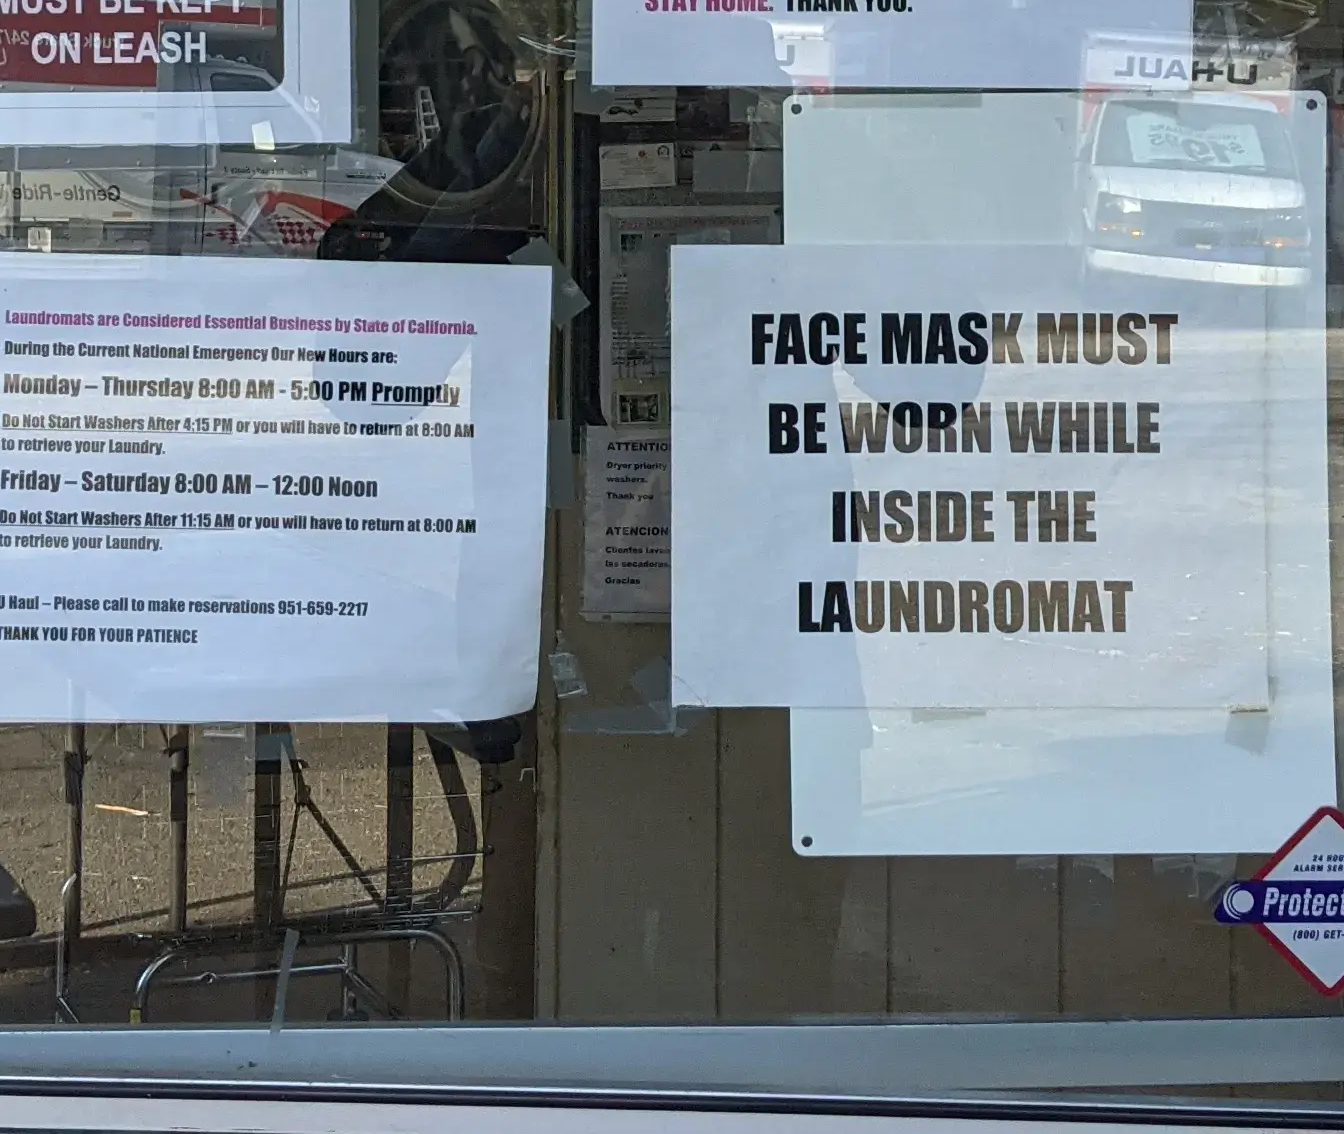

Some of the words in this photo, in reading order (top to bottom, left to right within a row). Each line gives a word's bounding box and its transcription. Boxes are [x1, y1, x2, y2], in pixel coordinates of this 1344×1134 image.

[31, 31, 83, 64] ON
[93, 31, 207, 64] LEASH
[3, 309, 95, 328] Laundromats
[95, 314, 121, 329] are
[121, 312, 202, 331] Considered
[203, 313, 268, 332] Essential
[267, 315, 333, 333] Business
[333, 316, 353, 338] by
[352, 316, 390, 335] State
[390, 317, 407, 335] of
[406, 318, 478, 337] California.
[750, 311, 868, 365] FACE
[879, 310, 1025, 365] MASK
[1035, 312, 1179, 365] MUST
[2, 339, 51, 362] During
[51, 340, 76, 358] the
[76, 341, 131, 359] Current
[131, 342, 190, 360] National
[191, 343, 269, 366] Emergency
[269, 345, 295, 363] Our
[295, 345, 327, 363] New
[327, 346, 369, 364] Hours
[369, 350, 398, 365] are:
[1, 373, 82, 401] Monday
[100, 375, 195, 403] Thursday
[196, 377, 242, 399] 8:00
[244, 378, 275, 400] AM
[289, 379, 334, 401] 5:00
[336, 380, 368, 402] PM
[370, 381, 461, 410] Promptly
[767, 400, 828, 454] BE
[837, 400, 992, 454] WORN
[1003, 400, 1161, 454] WHILE
[607, 442, 670, 452] ATTENTIO
[0, 469, 62, 497] Friday
[79, 471, 172, 499] Saturday
[172, 473, 219, 495] 8:00
[220, 474, 253, 496] AM
[270, 475, 325, 497] 12:00
[327, 476, 379, 498] Noon
[831, 489, 995, 544] INSIDE
[1005, 489, 1097, 544] THE
[7, 595, 40, 611] Haul
[52, 596, 101, 612] Please
[101, 597, 129, 613] call
[129, 598, 146, 613] to
[146, 598, 186, 614] make
[186, 599, 276, 616] reservations
[276, 601, 369, 618] 951-659-2217
[796, 575, 1134, 633] LAUNDROMAT
[1293, 864, 1324, 872] ALARM
[1312, 854, 1323, 862] 24
[1292, 929, 1320, 941] (800)
